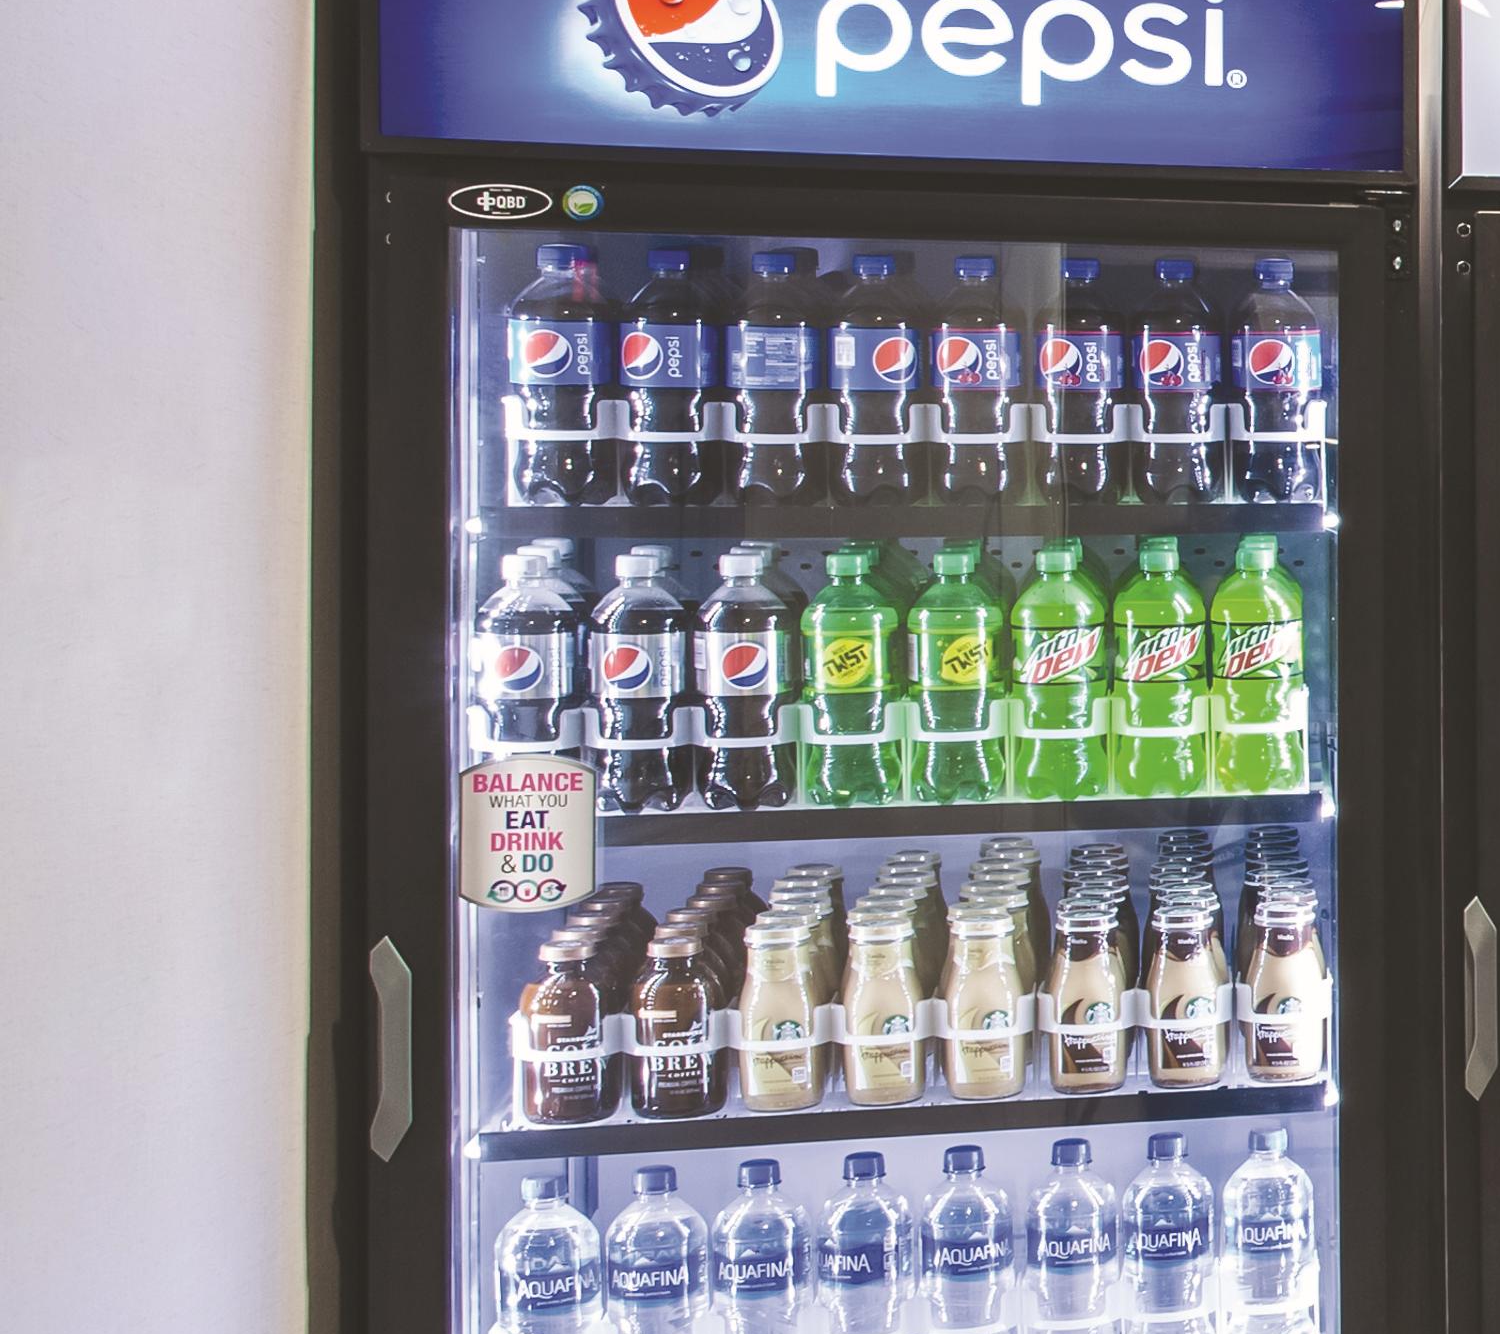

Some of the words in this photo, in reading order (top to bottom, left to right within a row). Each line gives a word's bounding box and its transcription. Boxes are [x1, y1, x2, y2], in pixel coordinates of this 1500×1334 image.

[497, 196, 525, 209] QBD
[668, 336, 683, 378] pepsi
[1086, 341, 1100, 383] pepsi
[473, 773, 583, 793] BALANCE
[489, 795, 532, 807] WHAT
[538, 795, 567, 807] YOU
[491, 832, 563, 851] DRINK
[501, 855, 516, 873] &
[522, 854, 553, 872] DO
[613, 1268, 688, 1289] AQUAFINA
[719, 1262, 792, 1281] AQUAFINA
